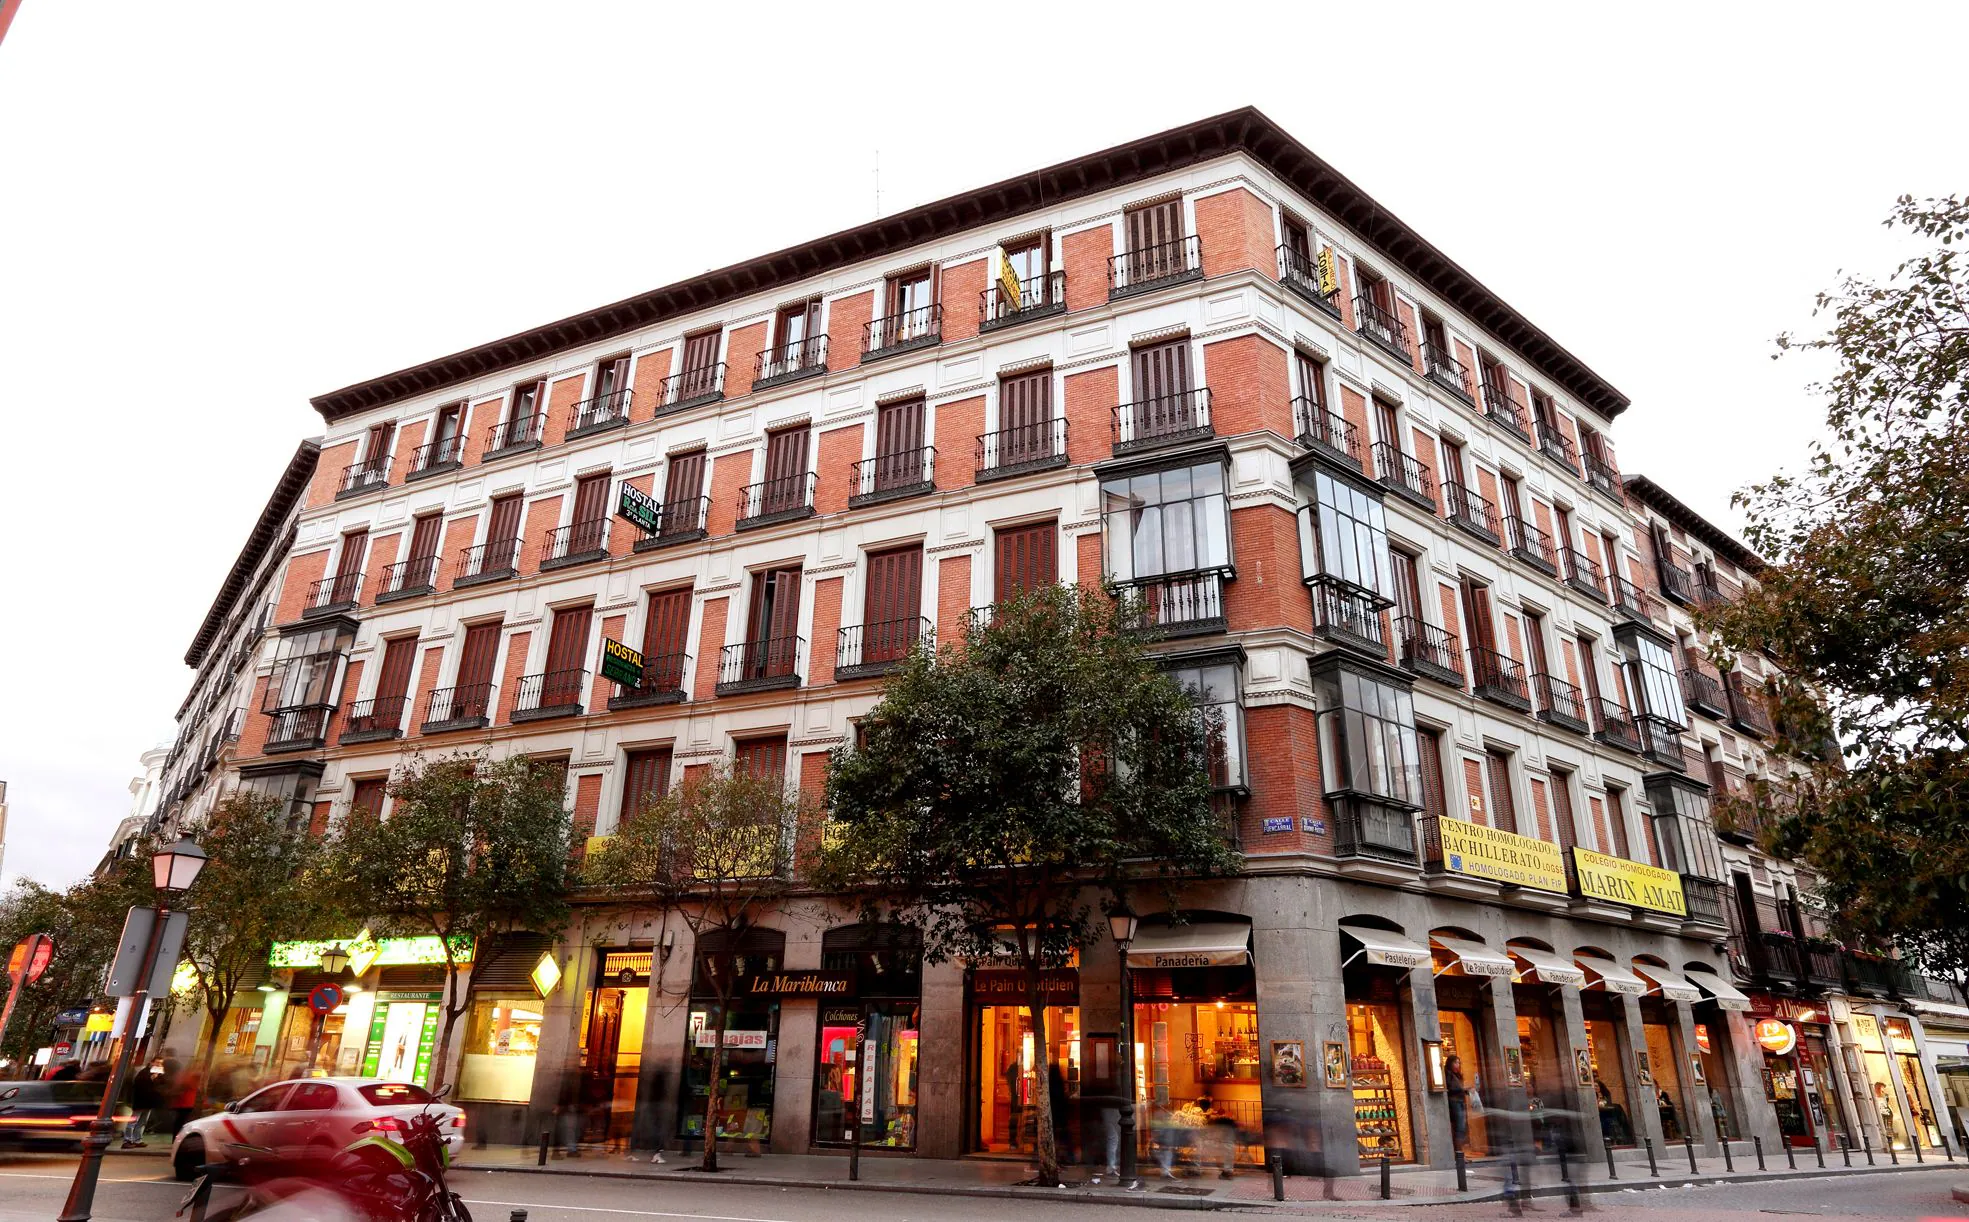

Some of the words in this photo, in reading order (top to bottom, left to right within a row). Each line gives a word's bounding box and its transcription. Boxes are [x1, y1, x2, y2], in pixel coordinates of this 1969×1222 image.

[1318, 251, 1329, 295] HOSTAL
[623, 482, 660, 514] HOSTAL
[632, 514, 650, 529] PLANTA
[607, 640, 643, 668] HOSTAL
[1441, 818, 1484, 838] CENTRO
[1486, 829, 1551, 854] HOMOLOGADO
[1443, 834, 1541, 869] BACHILLERATO
[1542, 863, 1564, 874] LOGSE
[1583, 853, 1617, 869] COLEGIO
[1620, 862, 1672, 882] HOMOLOGADO
[1468, 861, 1525, 881] HOMOLOGADO
[1529, 874, 1548, 886] PLAN
[1579, 868, 1637, 902] MARIN
[1643, 883, 1683, 911] AMAT
[1155, 955, 1209, 967] Panadería
[1466, 962, 1474, 973] Le
[750, 975, 769, 993] La
[770, 975, 848, 993] Mariblanca
[975, 979, 987, 992] Le
[990, 978, 1014, 992] Pain
[1017, 978, 1074, 992] Qtidien
[824, 1009, 858, 1022] Colchones
[864, 1044, 875, 1116] REBAJAS
